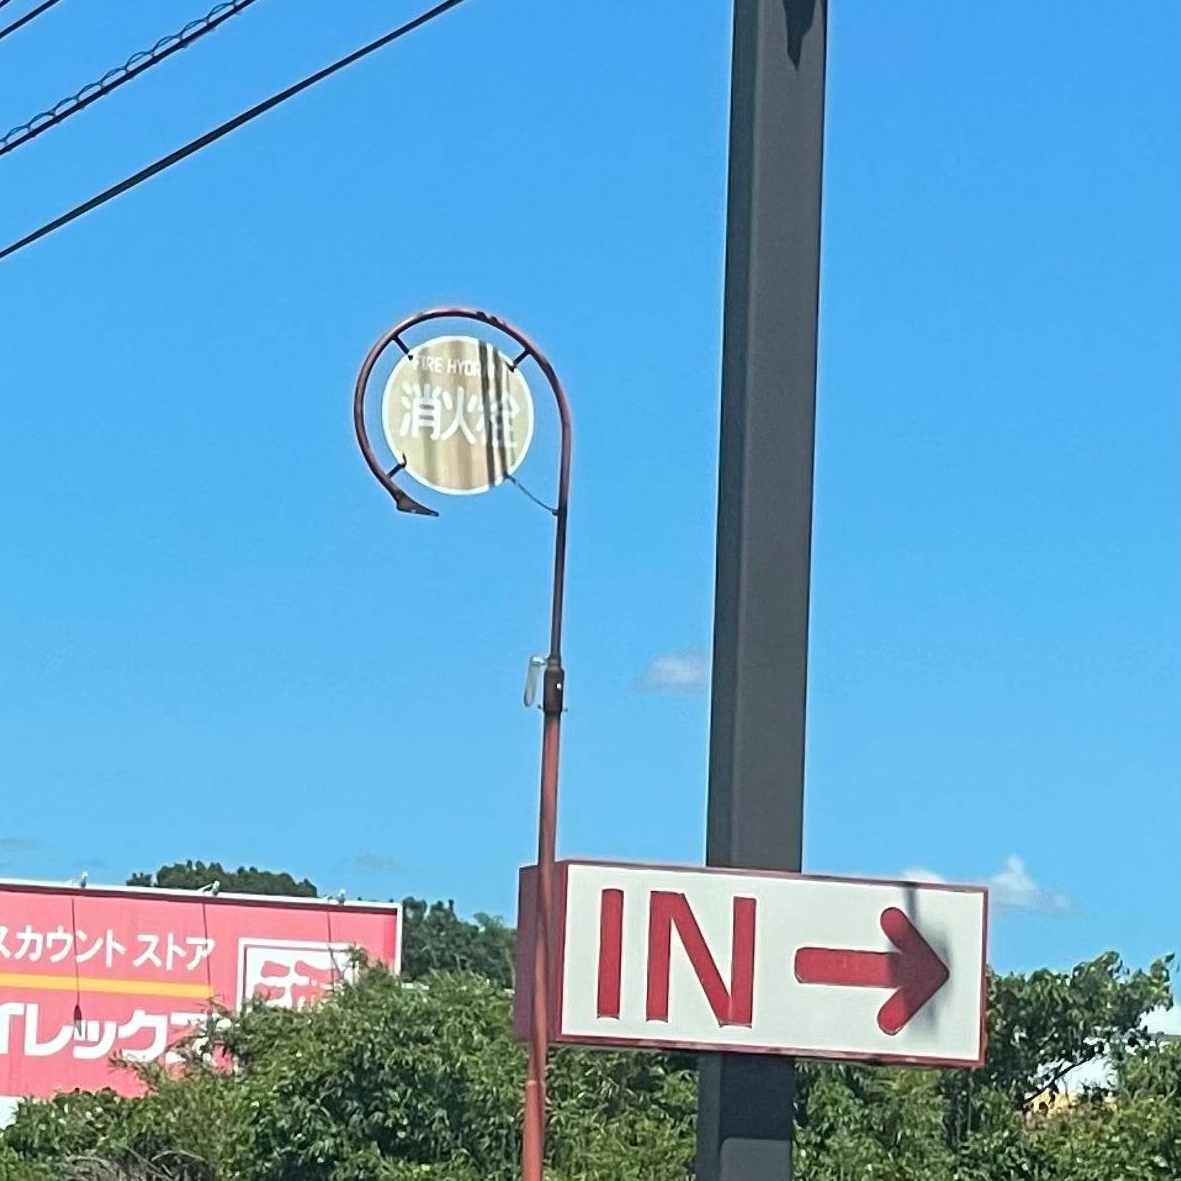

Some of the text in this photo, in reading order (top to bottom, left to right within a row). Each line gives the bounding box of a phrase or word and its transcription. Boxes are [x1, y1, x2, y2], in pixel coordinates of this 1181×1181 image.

[412, 355, 442, 374] FIRE
[133, 933, 215, 971] ストア
[596, 887, 757, 1029] IN
